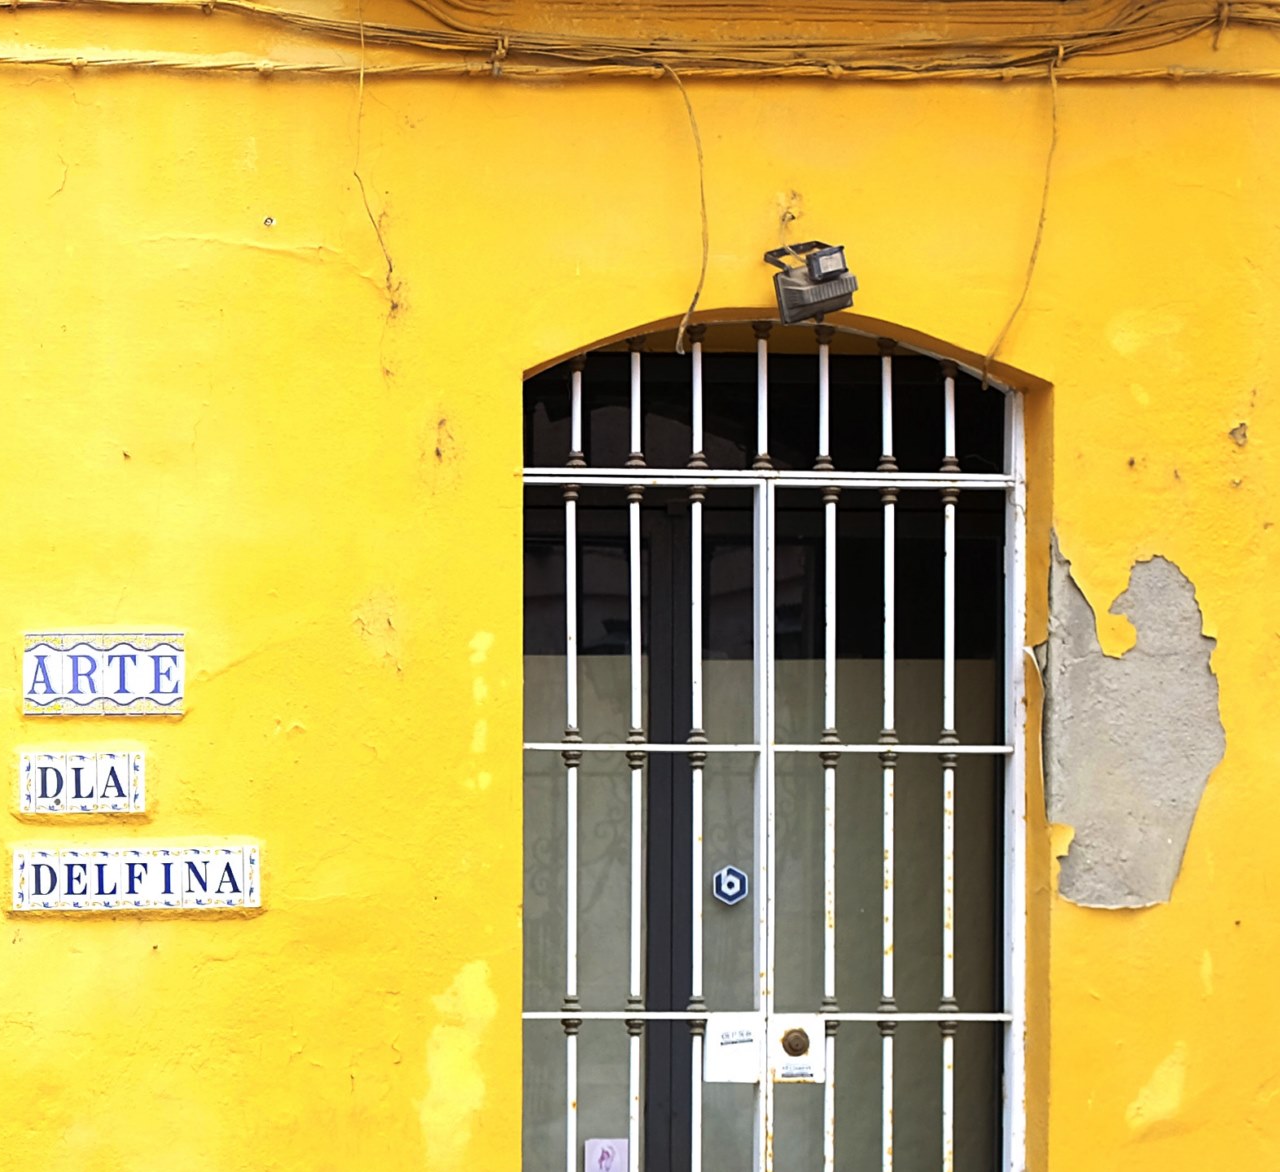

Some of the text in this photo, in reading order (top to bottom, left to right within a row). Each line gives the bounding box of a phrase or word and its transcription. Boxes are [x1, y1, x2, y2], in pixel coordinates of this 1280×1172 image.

[27, 654, 179, 695] ARTE
[37, 765, 127, 799] DLA
[31, 860, 242, 896] DELFINA
